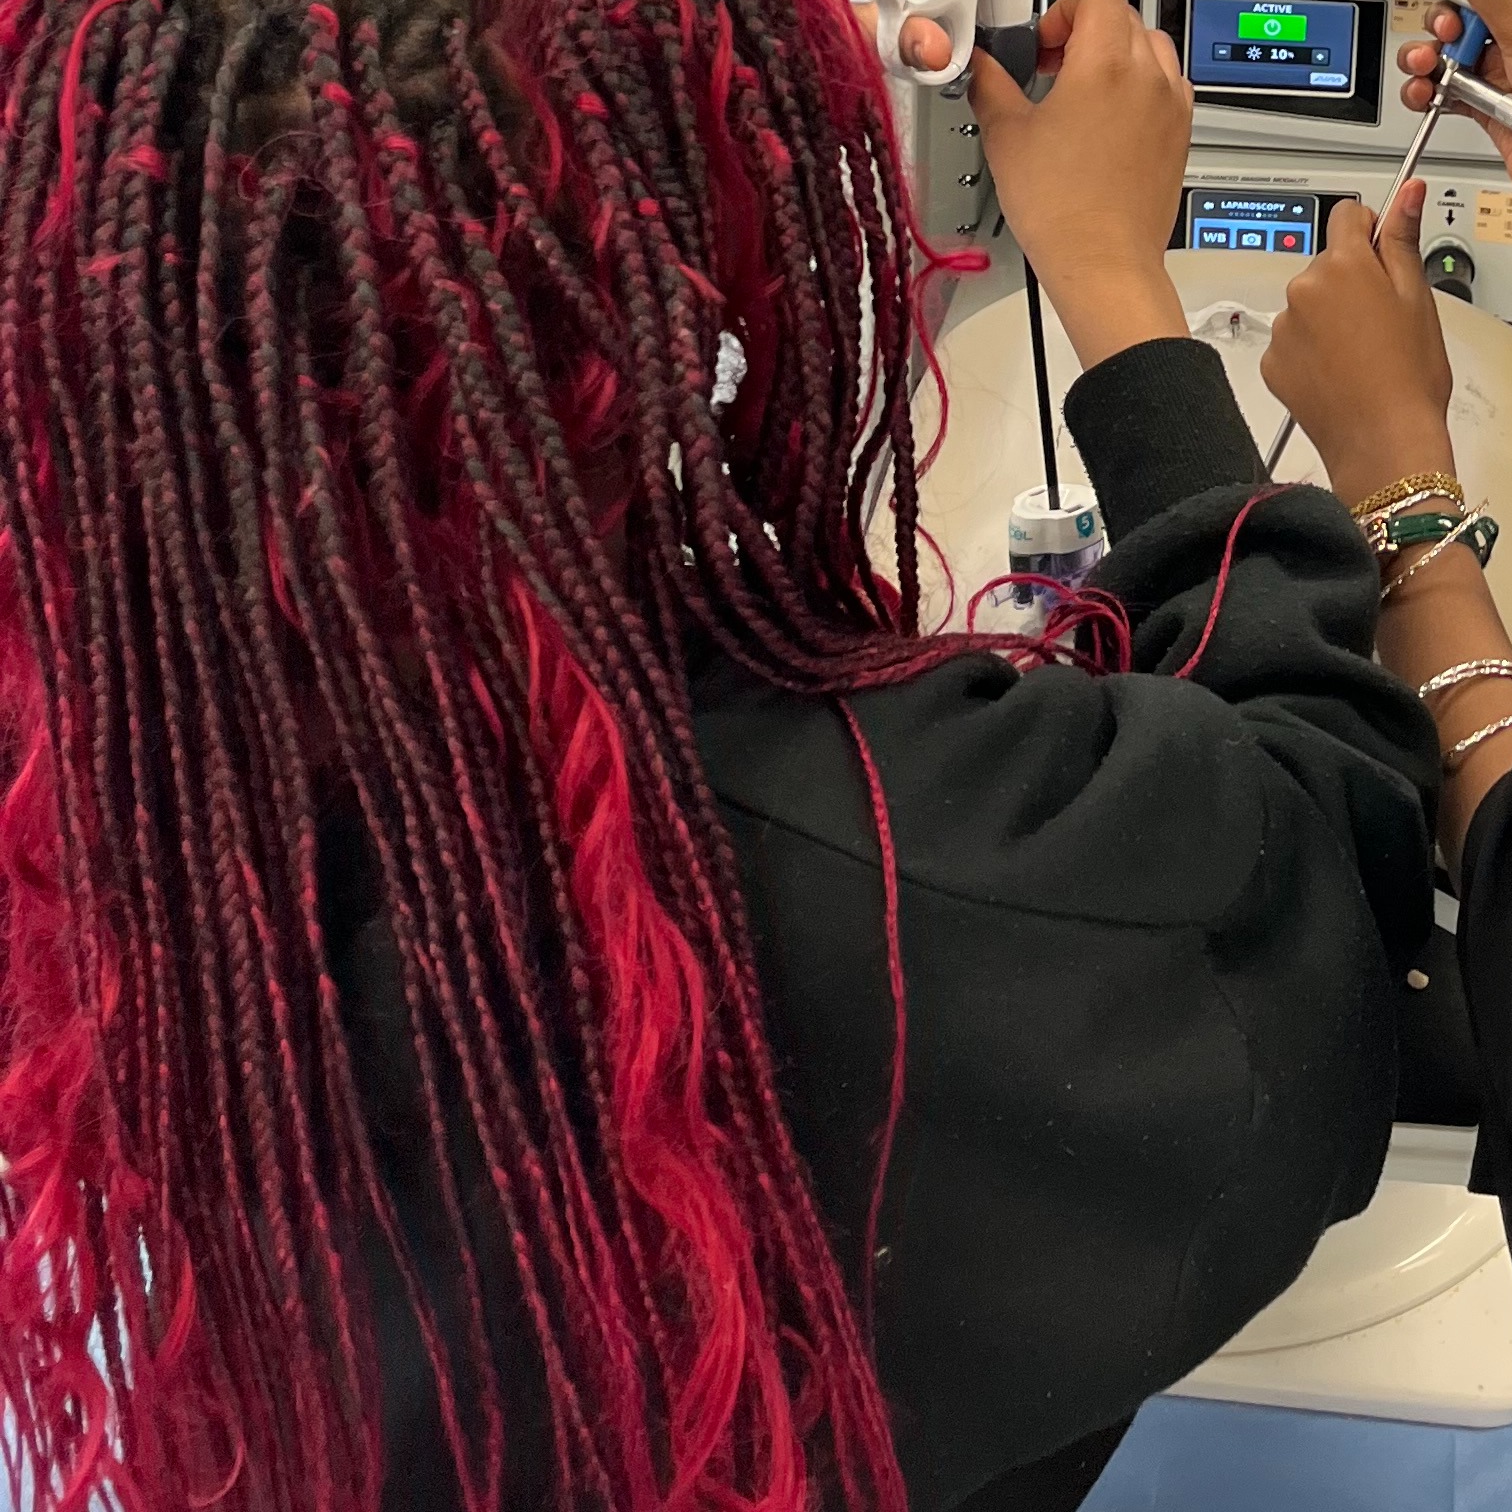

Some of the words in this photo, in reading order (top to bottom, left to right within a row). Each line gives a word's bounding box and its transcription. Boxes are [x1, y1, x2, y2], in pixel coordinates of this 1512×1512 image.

[1253, 3, 1292, 14] ACTIVE
[1221, 200, 1286, 212] LAPAROSCOPY
[1203, 232, 1226, 244] WB
